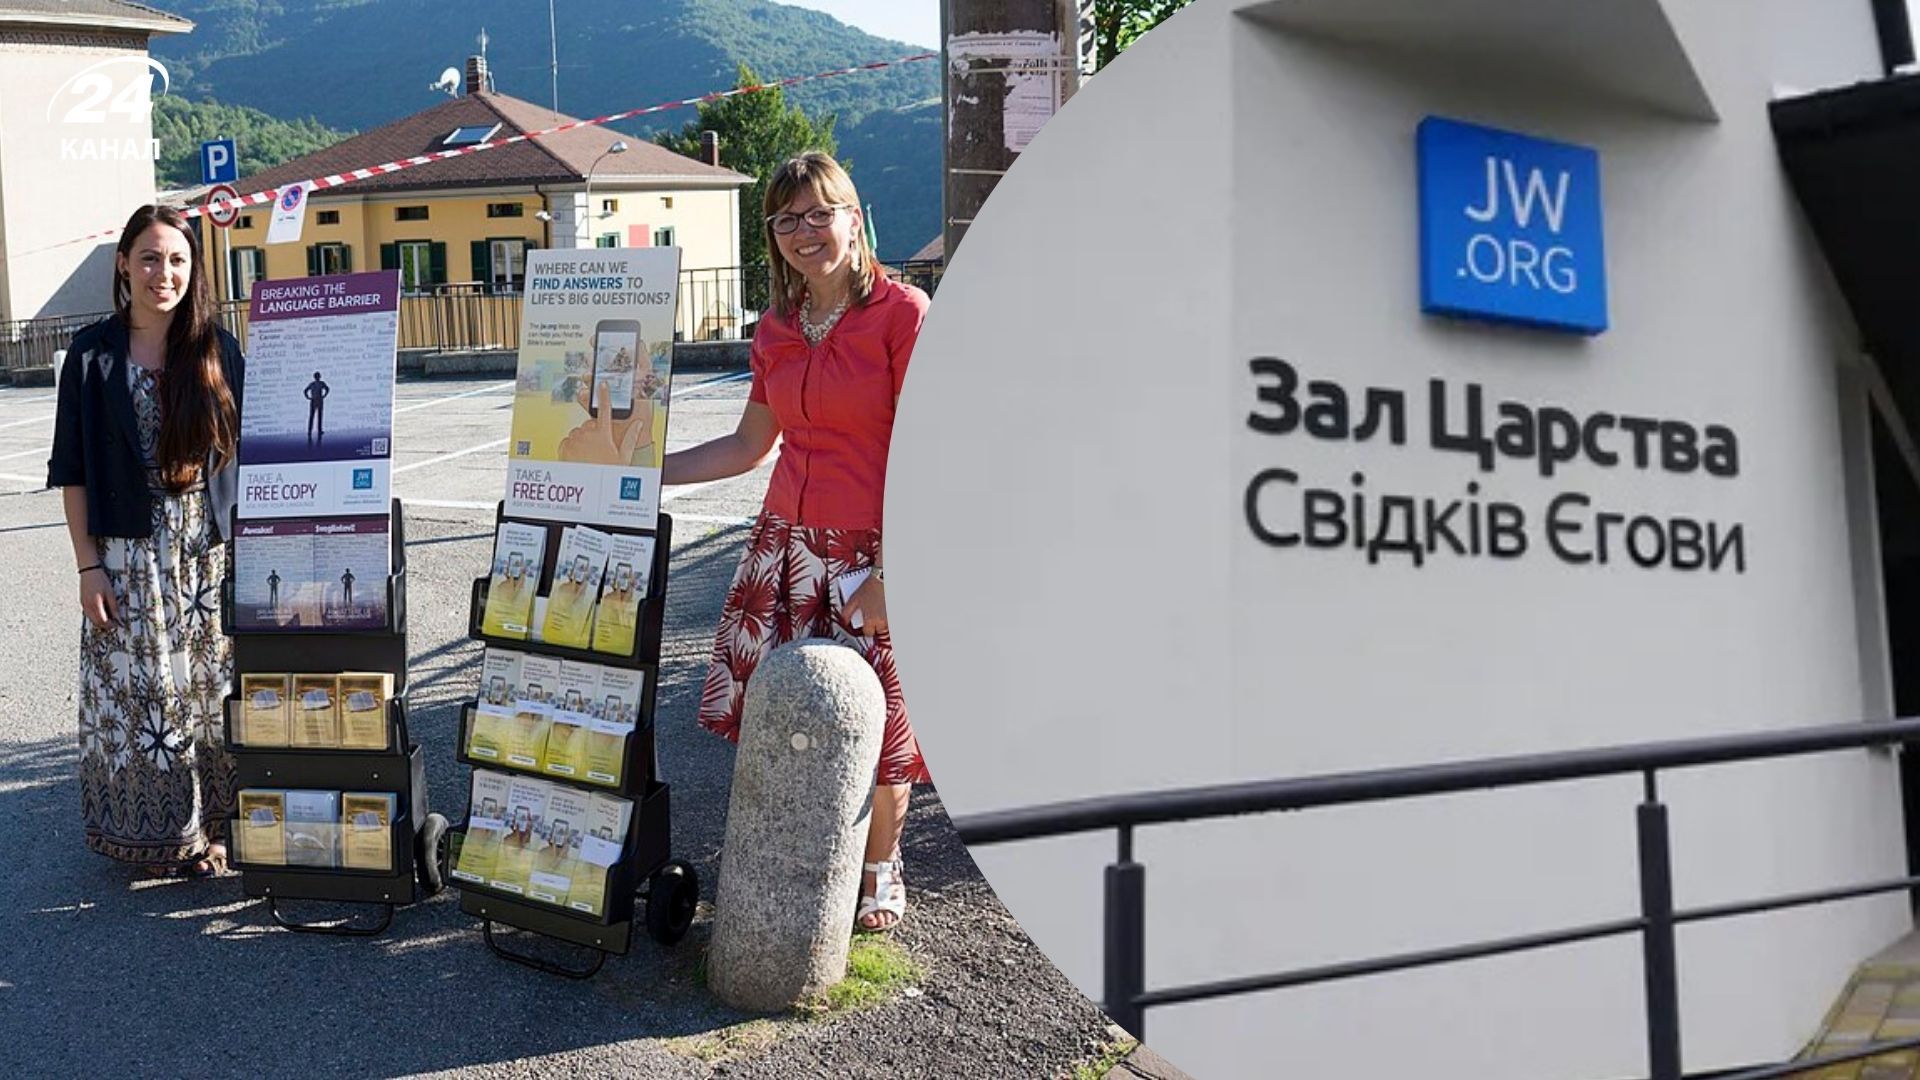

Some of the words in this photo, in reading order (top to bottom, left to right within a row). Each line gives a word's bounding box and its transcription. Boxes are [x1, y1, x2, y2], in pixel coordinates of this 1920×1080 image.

[207, 145, 228, 180] P
[1464, 156, 1571, 234] JW
[534, 262, 576, 275] WHERE
[579, 262, 605, 274] CAN
[608, 261, 628, 274] WE
[1455, 233, 1578, 295] .ORG
[261, 285, 320, 300] BREAKING
[324, 282, 346, 295] THE
[532, 277, 561, 290] FIND
[563, 277, 623, 290] ANSWERS
[627, 277, 643, 289] TO
[260, 298, 325, 313] LANGUAGE
[328, 294, 381, 309] BARRIER
[531, 292, 565, 305] LIFE'S
[568, 292, 589, 305] BIG
[592, 292, 671, 305] QUESTIONS?
[1246, 356, 1406, 446] Зал
[1428, 377, 1740, 479] Царства
[247, 472, 273, 484] TAKE
[275, 472, 284, 483] A
[515, 469, 541, 482] TAKE
[543, 471, 552, 482] A
[625, 480, 638, 489] JW
[246, 484, 279, 501] FREE
[281, 483, 318, 500] COPY
[513, 482, 545, 501] FREE
[548, 484, 585, 504] COPY
[1244, 467, 1529, 568] Свідків
[1544, 491, 1746, 574] Єгови
